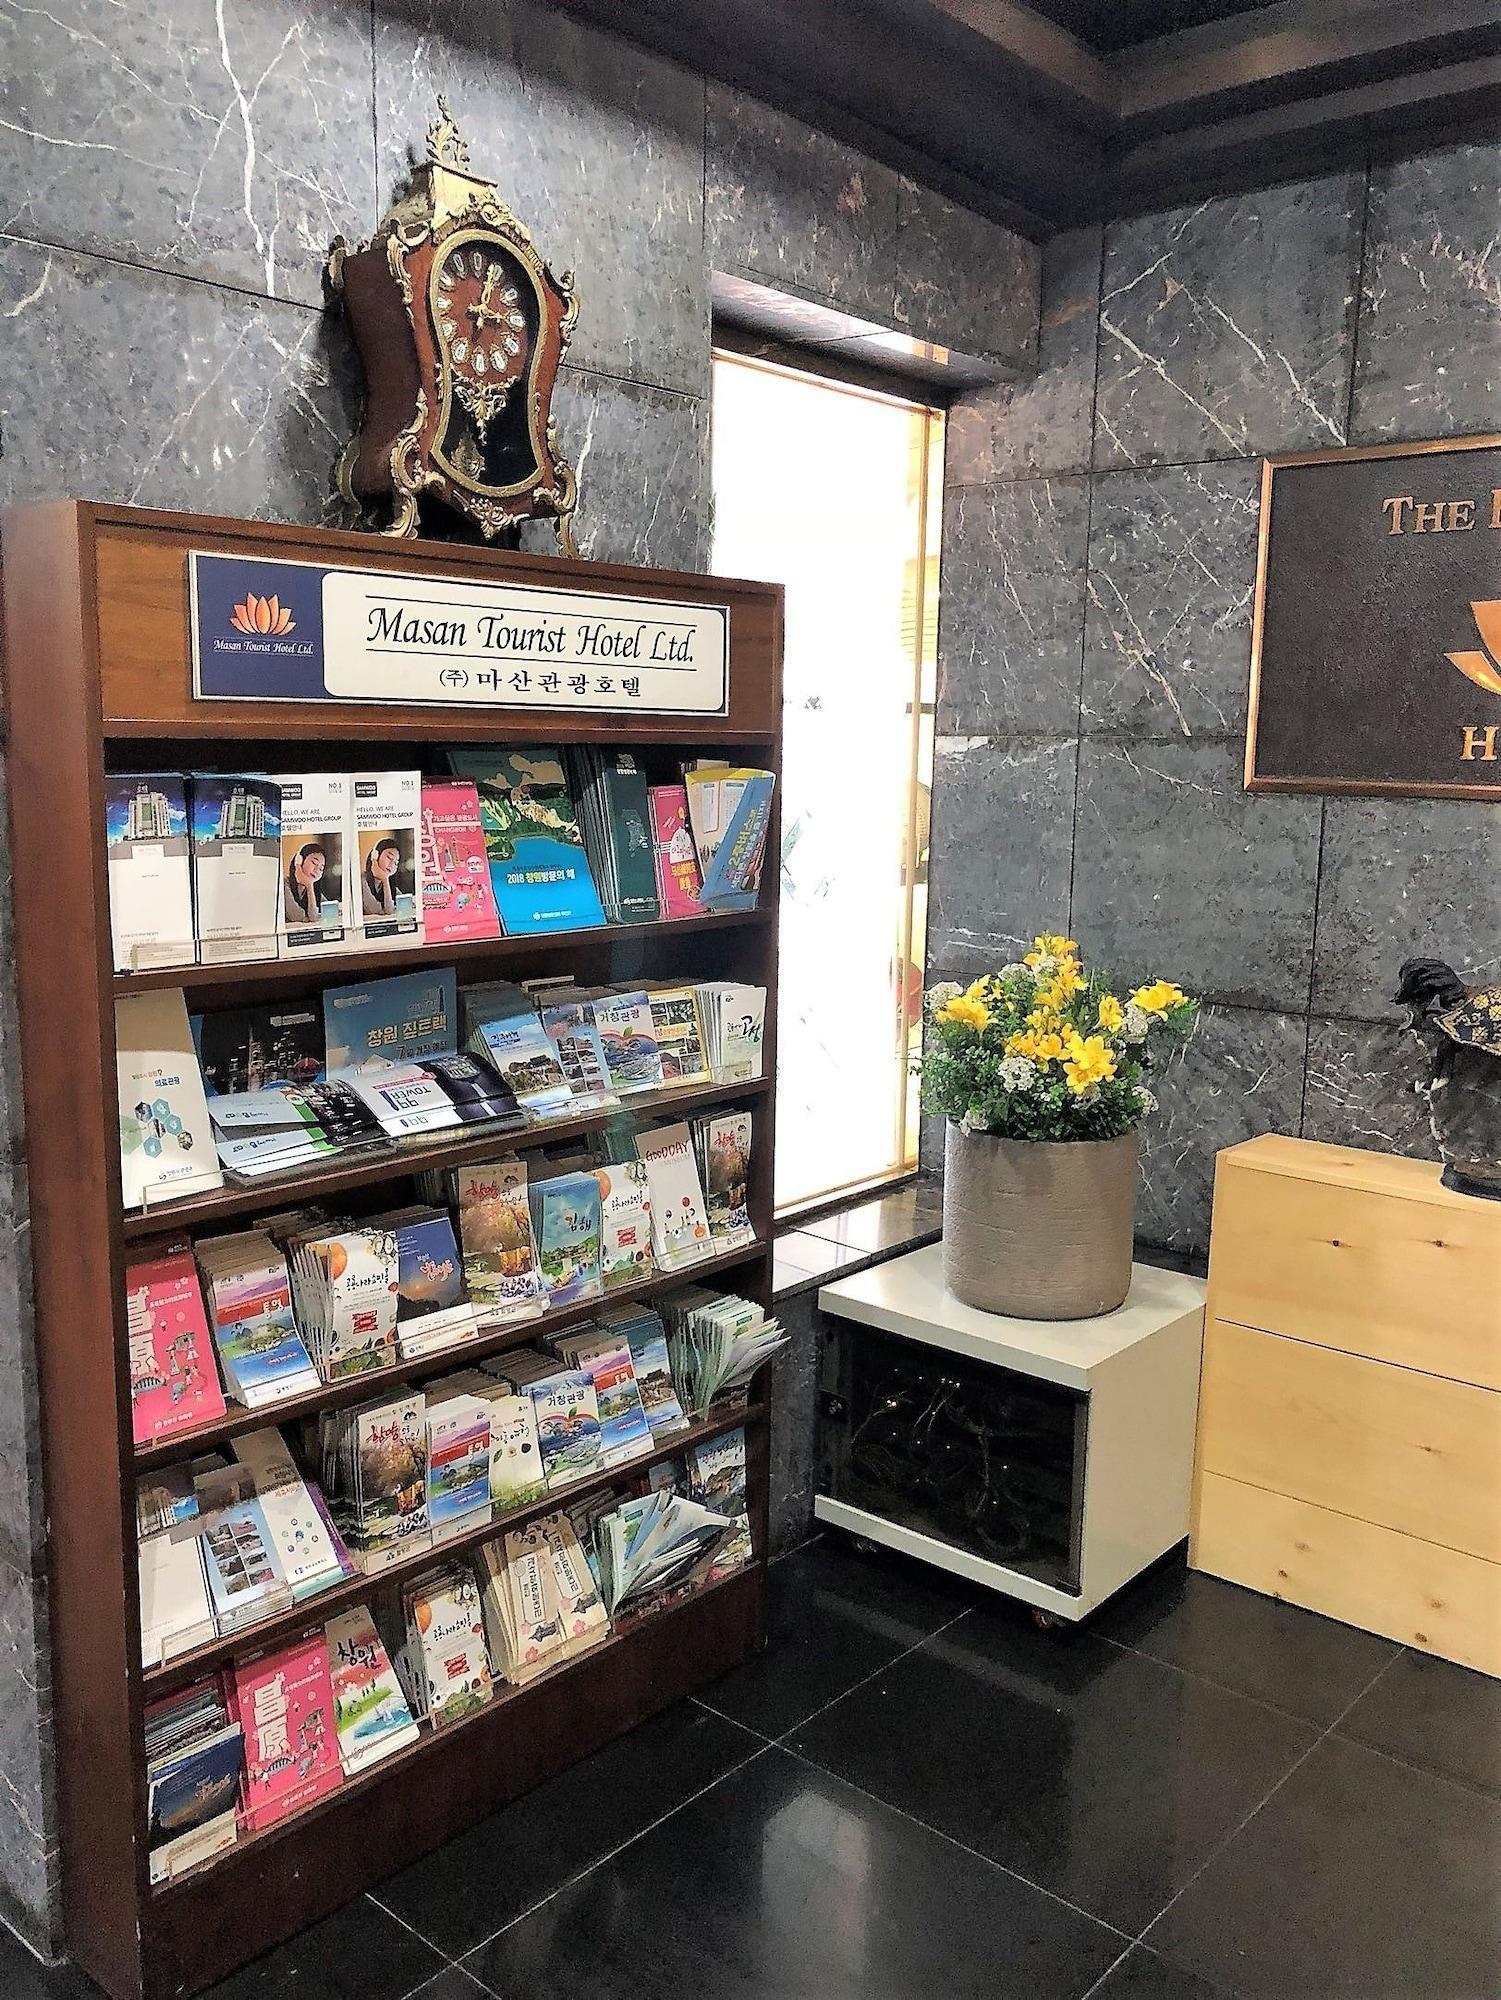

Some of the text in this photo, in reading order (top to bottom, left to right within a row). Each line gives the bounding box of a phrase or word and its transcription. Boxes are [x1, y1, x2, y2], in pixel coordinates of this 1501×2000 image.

[1383, 496, 1475, 535] THE
[366, 607, 696, 662] Masan Tourist Hotel Ltd.
[213, 639, 241, 651] Masan
[243, 640, 270, 652] Tourist
[271, 642, 295, 654] Hotel
[507, 872, 524, 884] 2018
[368, 1023, 398, 1048] 창원
[391, 1086, 432, 1101] TOWER
